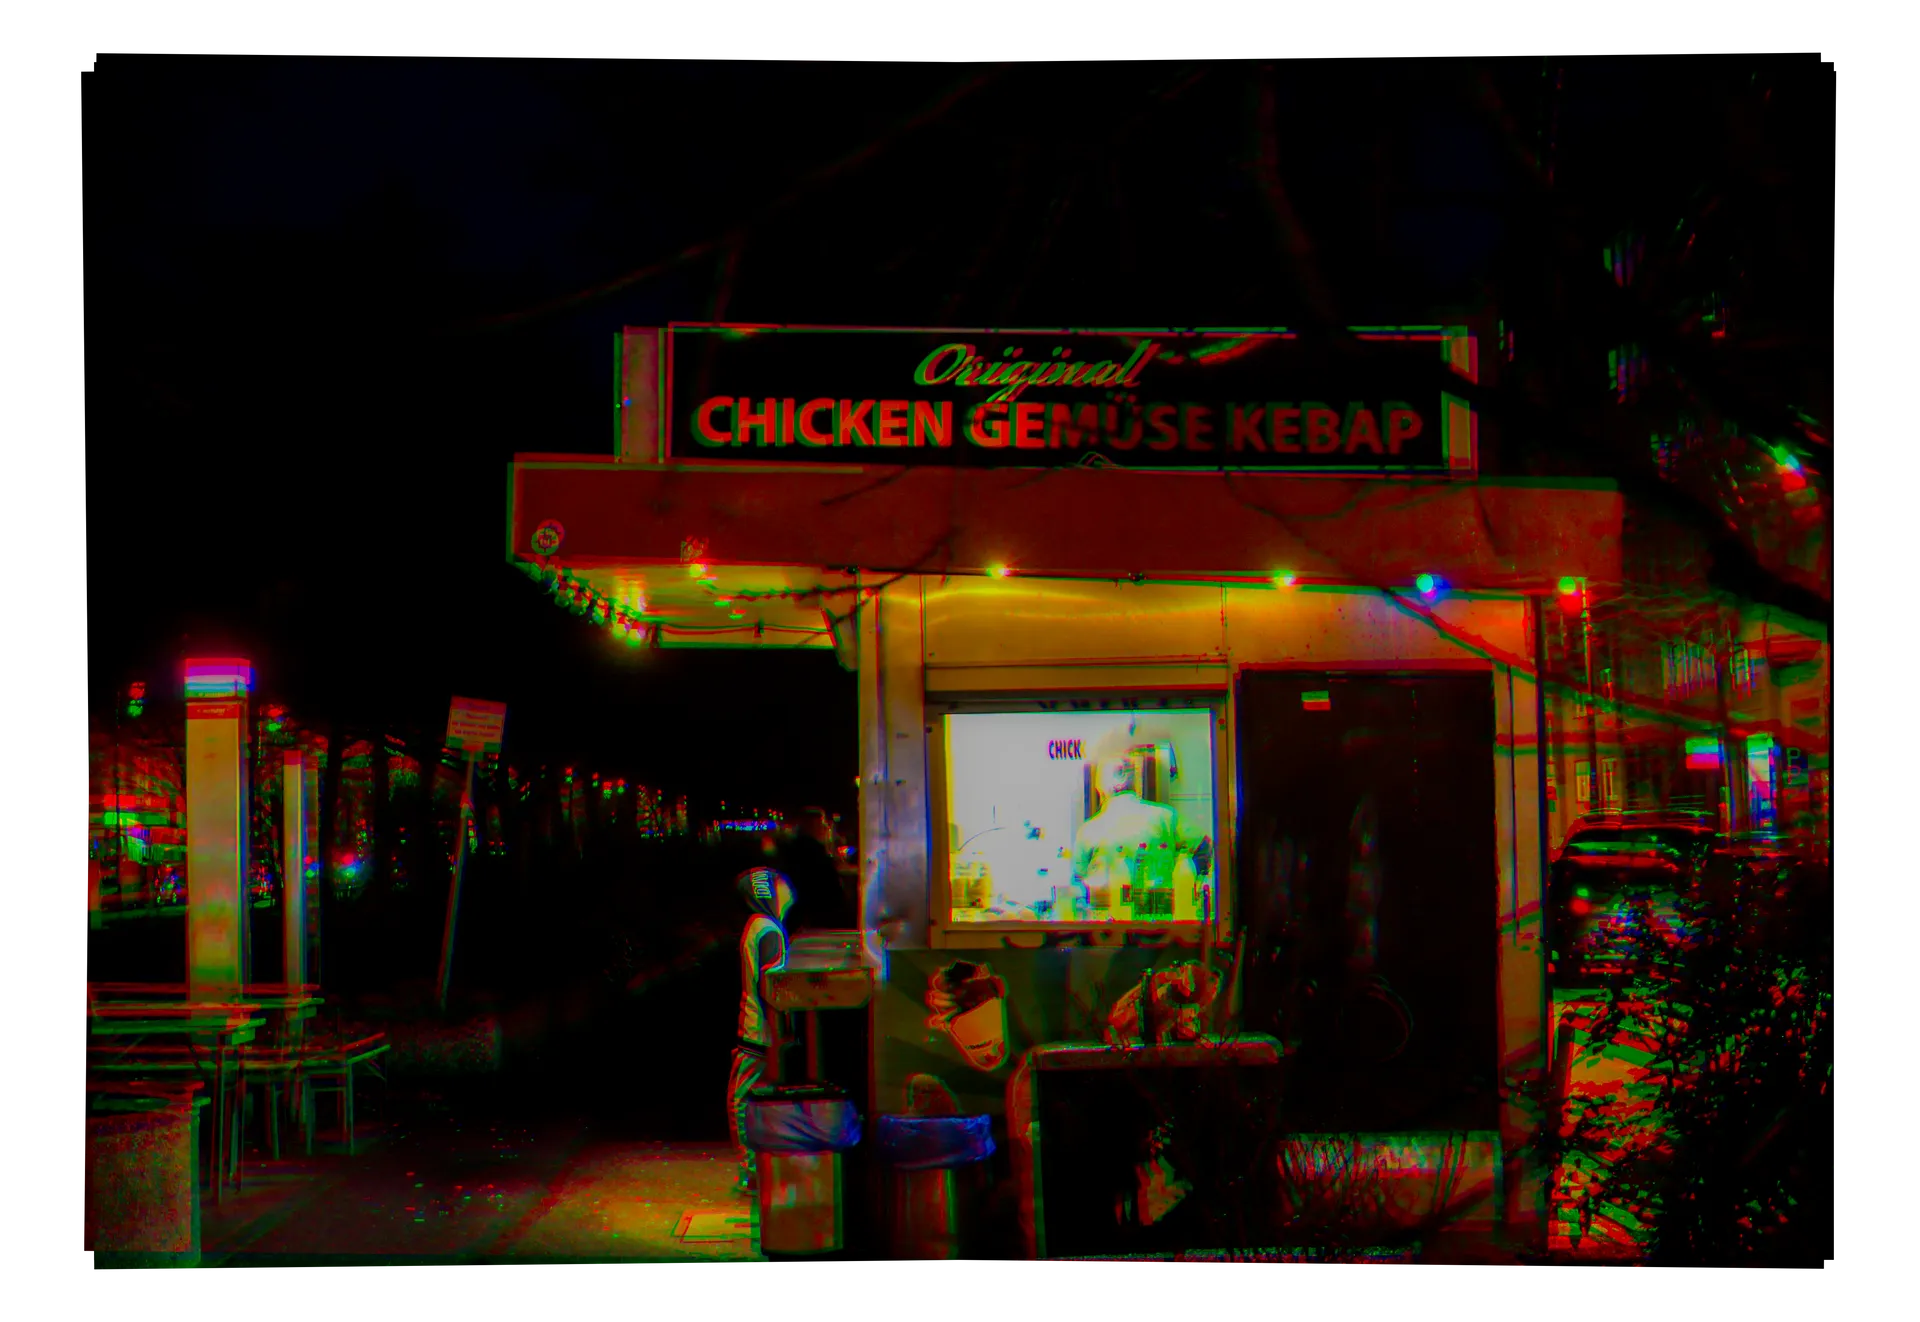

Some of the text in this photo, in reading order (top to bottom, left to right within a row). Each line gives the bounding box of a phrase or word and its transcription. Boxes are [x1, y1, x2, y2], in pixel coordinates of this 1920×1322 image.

[692, 394, 1424, 455] CHICKEN GEMÜSE KEBAP
[1048, 740, 1083, 760] CHICK
